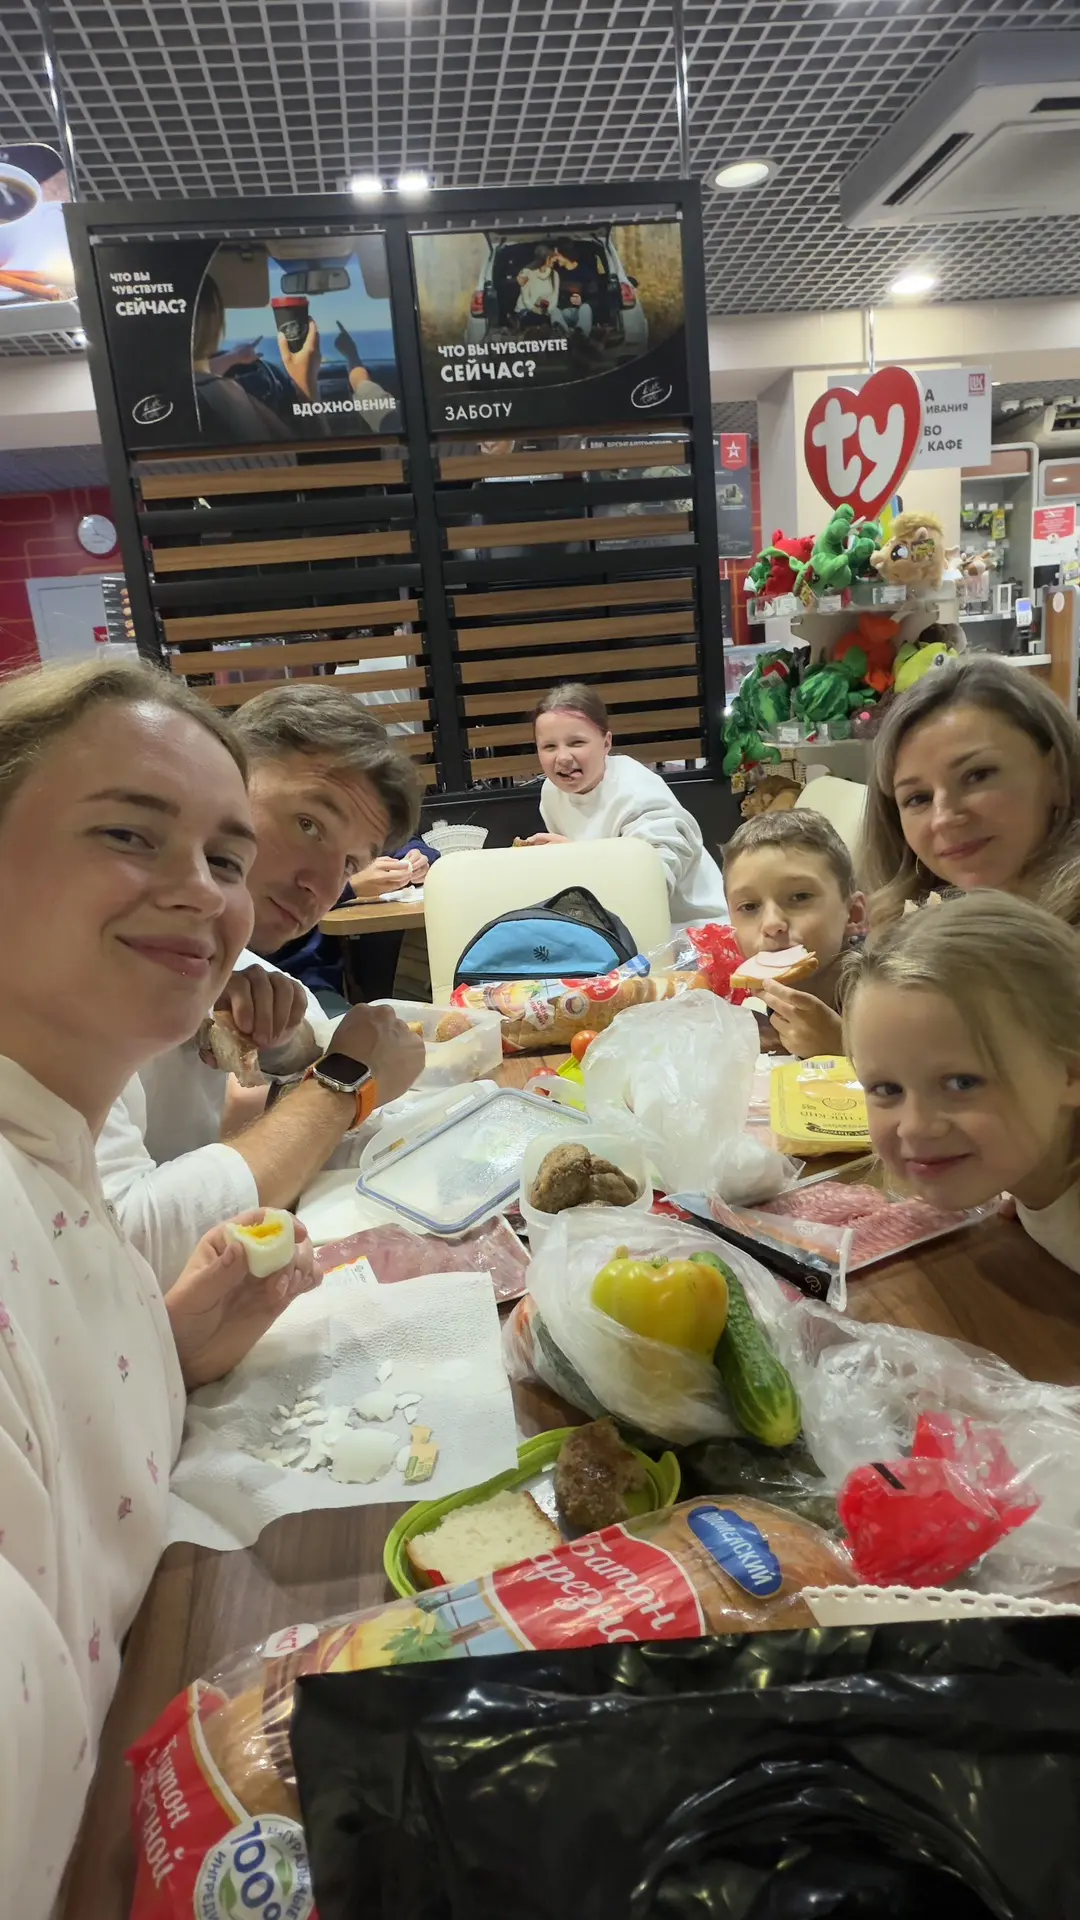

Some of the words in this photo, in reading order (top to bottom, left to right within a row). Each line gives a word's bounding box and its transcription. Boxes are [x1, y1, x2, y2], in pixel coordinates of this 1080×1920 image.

[110, 272, 132, 283] ЧТО
[133, 271, 150, 281] ВЫ
[112, 283, 174, 294] ЧУВСТВУЕТЕ
[115, 297, 187, 316] СЕЙЧАС?
[438, 345, 465, 358] ЧТО
[468, 343, 489, 357] ВЫ
[490, 339, 568, 355] ЧУВСТВУЕТЕ
[440, 359, 536, 383] СЕЙЧАС?
[292, 397, 396, 417] ВДОХНОВЕНИЕ
[445, 402, 513, 421] ЗАБОТУ
[926, 403, 968, 414] ИВАНИЯ
[924, 425, 942, 436] ВО
[812, 397, 905, 503] ty
[927, 439, 963, 452] КАФЕ
